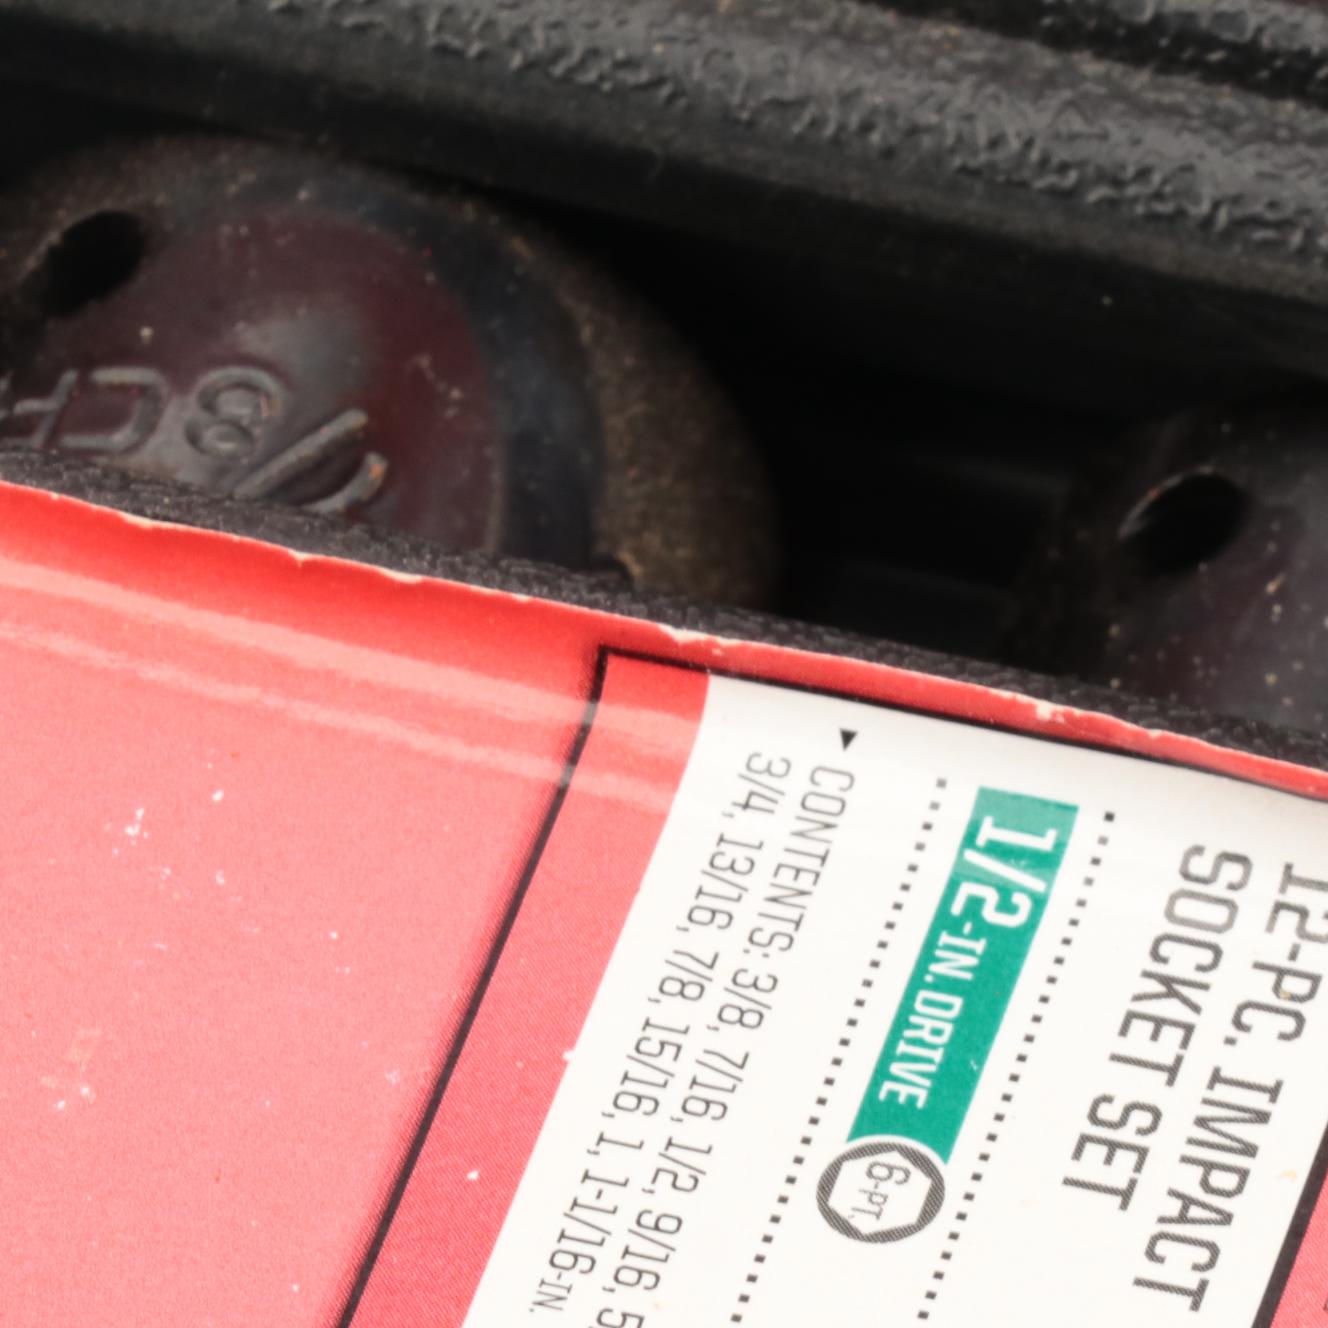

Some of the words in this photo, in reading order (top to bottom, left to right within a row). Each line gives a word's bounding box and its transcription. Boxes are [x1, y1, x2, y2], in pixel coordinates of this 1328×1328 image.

[720, 752, 792, 821] 3/4,
[676, 833, 764, 933] 13/16,
[743, 766, 855, 959] CONTENTS:
[647, 951, 720, 1005] 7/8,
[706, 967, 779, 1032] 3/8,
[1107, 844, 1254, 1087] SOCKET
[602, 1017, 690, 1119] 15/16,
[670, 1049, 750, 1122] 7/16,
[878, 990, 963, 1109] DRIVE
[586, 1131, 645, 1156] 1,
[641, 1137, 713, 1195] 1/2,
[1061, 1094, 1164, 1211] SET
[849, 1160, 910, 1220] 6-PT.
[1131, 1066, 1283, 1312] IMPACT
[602, 1209, 683, 1293] 9/16,
